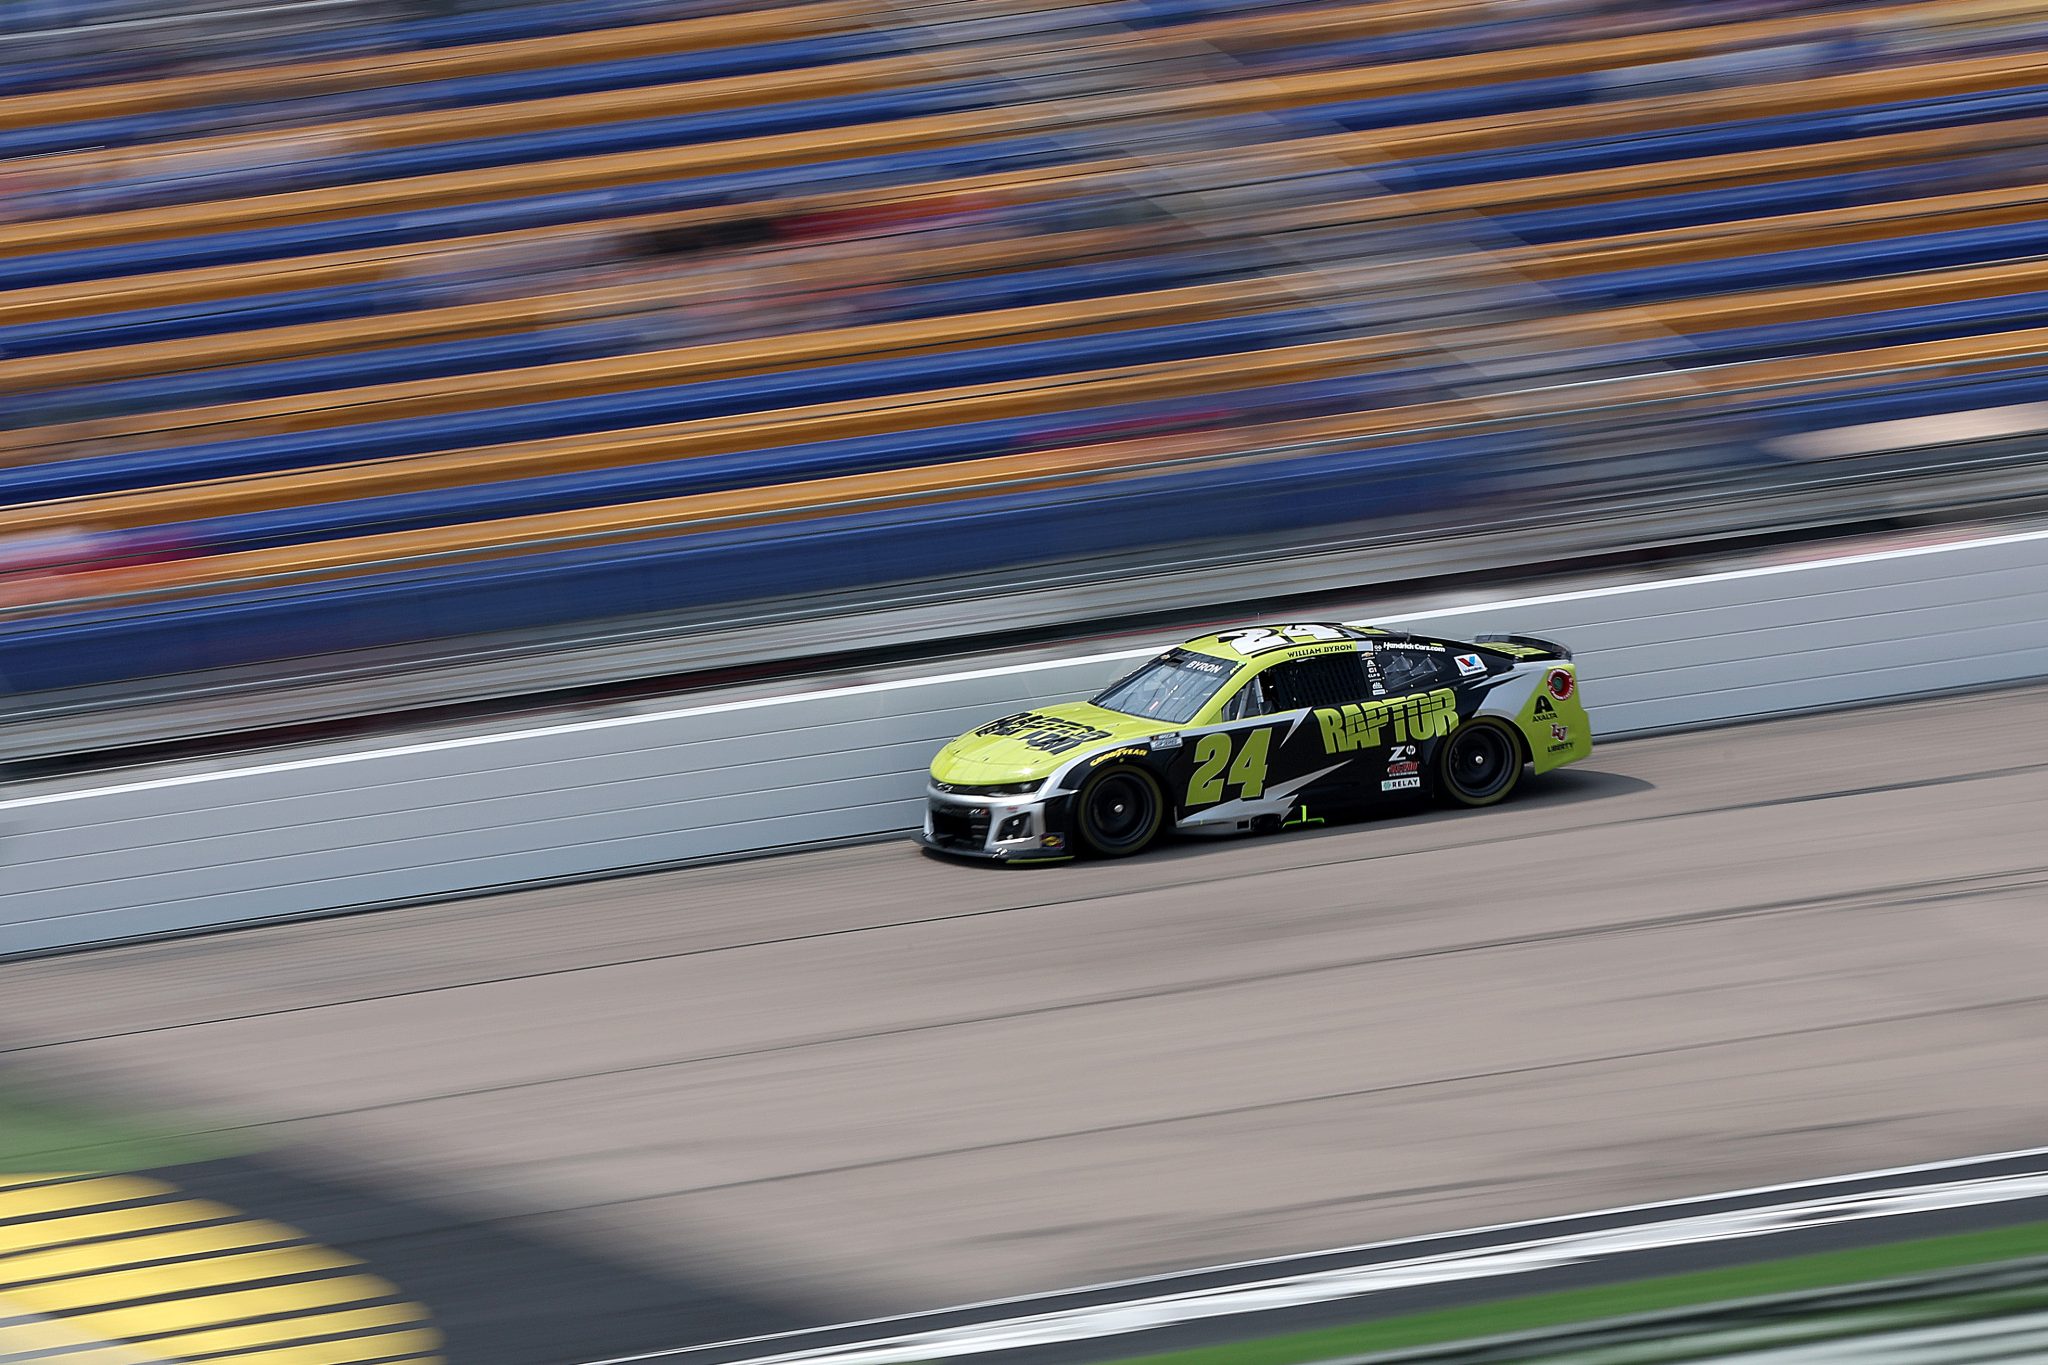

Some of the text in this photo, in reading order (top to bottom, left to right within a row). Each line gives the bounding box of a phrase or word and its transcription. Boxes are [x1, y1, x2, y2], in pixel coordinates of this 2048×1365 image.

[1217, 624, 1345, 656] 24
[1383, 641, 1446, 653] HendrickCars.com
[1287, 643, 1352, 658] WILLIAM BYRON
[1186, 660, 1223, 674] BYRON
[1312, 688, 1460, 754] RAPTOR
[1532, 712, 1558, 723] AXALTA
[1547, 742, 1574, 752] LIBERTY
[1185, 727, 1273, 807] 24
[1392, 778, 1418, 788] RELAY
